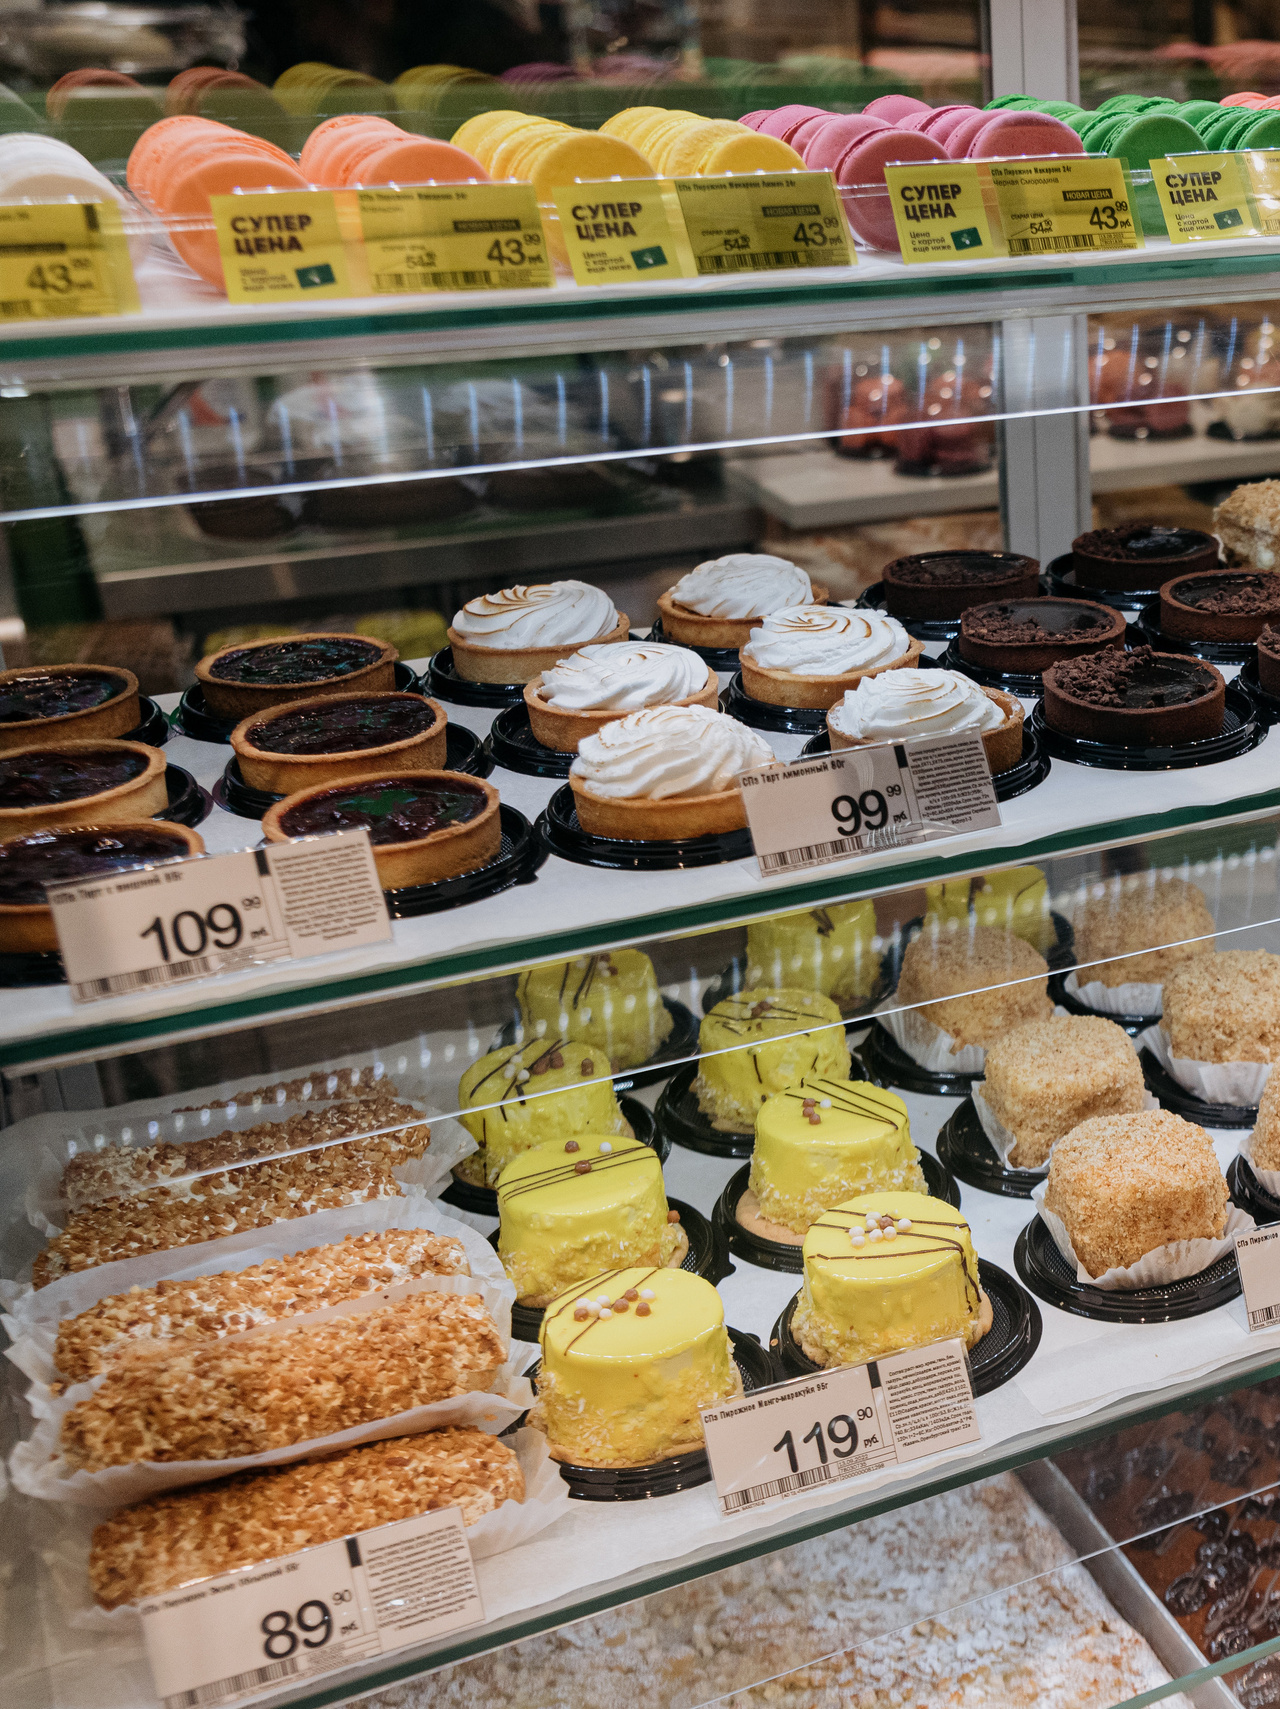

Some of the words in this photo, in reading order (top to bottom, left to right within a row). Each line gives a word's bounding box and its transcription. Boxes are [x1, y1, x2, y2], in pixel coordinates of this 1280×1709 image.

[1019, 177, 1059, 185] Смородина
[1164, 170, 1222, 188] СУПЕР
[900, 184, 962, 202] СУПЕР
[1065, 191, 1090, 200] НОВАЯ
[1090, 190, 1110, 198] ЦЕНА
[1169, 188, 1218, 206] ЦЕНА
[570, 201, 643, 221] СУПЕР
[766, 206, 793, 216] НОВАЯ
[794, 205, 817, 214] ЦЕНА
[904, 202, 956, 221] ЦЕНА
[1087, 205, 1118, 230] 43
[1115, 201, 1128, 211] 99
[230, 213, 313, 235] СУПЕР
[576, 221, 637, 242] ЦЕНА
[792, 222, 826, 247] 43
[823, 216, 838, 228] 99
[1029, 222, 1044, 234] 54
[1183, 218, 1209, 226] картой
[234, 235, 304, 258] ЦЕНА
[485, 238, 526, 267] 43
[522, 233, 541, 246] 99
[918, 237, 945, 245] картой
[27, 263, 73, 294] 43
[761, 774, 780, 784] Тарт
[783, 762, 829, 780] лимонный
[831, 759, 845, 770] 80г
[831, 789, 888, 836] 99
[886, 784, 902, 797] 99
[140, 903, 242, 962] 109
[1250, 1233, 1278, 1244] Пирожное
[720, 1403, 756, 1419] Пирожное
[758, 1386, 815, 1408] Манго-маракуйя
[816, 1382, 828, 1391] 95г
[773, 1414, 859, 1473] 119
[857, 1406, 873, 1421] 90
[863, 1434, 879, 1448] руб.
[839, 1453, 868, 1467] 13.09.2022
[261, 1599, 333, 1660] 89
[332, 1589, 352, 1606] 90
